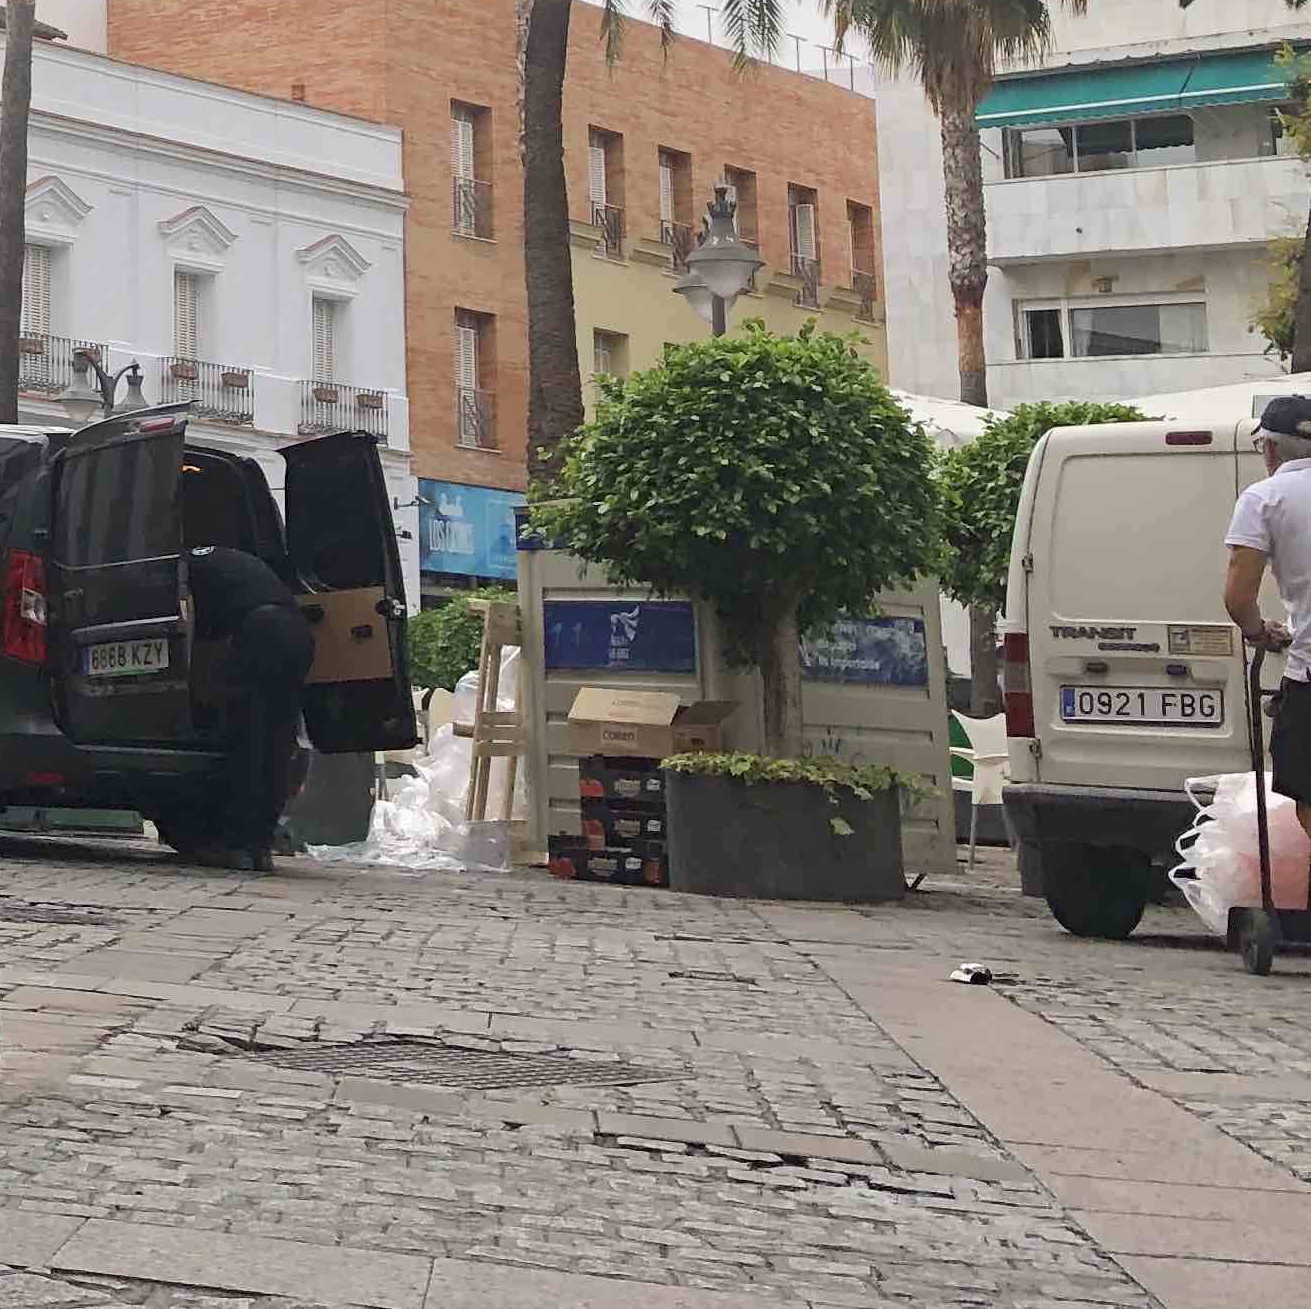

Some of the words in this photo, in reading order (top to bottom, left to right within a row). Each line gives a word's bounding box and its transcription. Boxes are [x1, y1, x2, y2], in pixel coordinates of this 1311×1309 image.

[131, 641, 164, 666] KZY
[1079, 691, 1147, 716] 0921
[1161, 693, 1215, 718] FBG
